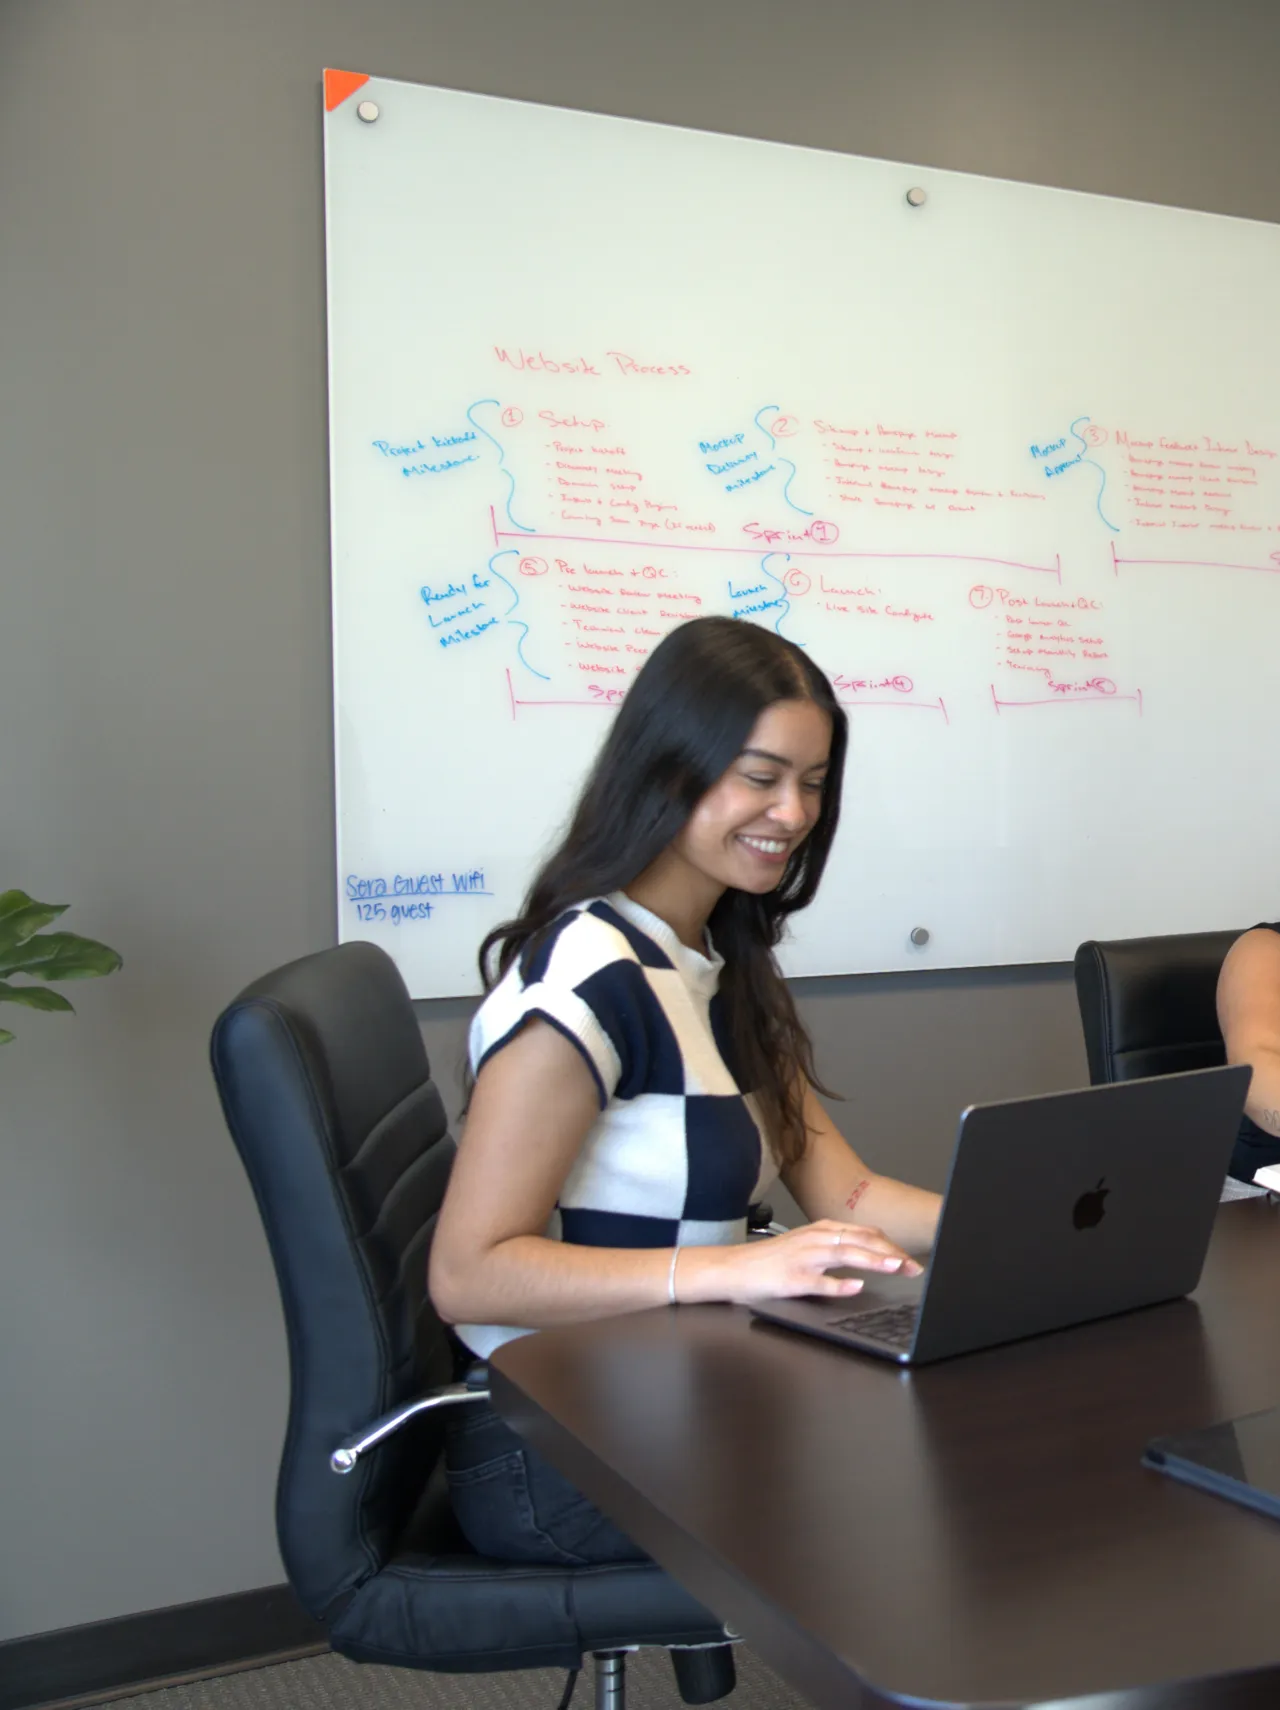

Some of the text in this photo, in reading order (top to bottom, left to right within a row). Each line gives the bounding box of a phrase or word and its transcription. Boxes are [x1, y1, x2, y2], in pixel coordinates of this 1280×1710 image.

[494, 346, 691, 376] Website Process
[372, 440, 425, 457] Project
[402, 454, 480, 478] Milestone
[706, 451, 758, 475] Delivery
[742, 523, 811, 544] Sprint
[421, 574, 489, 605] Ready for
[729, 581, 768, 598] Launch
[996, 588, 1028, 606] Post
[428, 602, 486, 627] Launch
[833, 675, 892, 692] Sprint
[1048, 680, 1092, 694] Sprint
[346, 874, 387, 897] Sera
[394, 874, 444, 896] Guest
[357, 902, 434, 926] 125 guest
